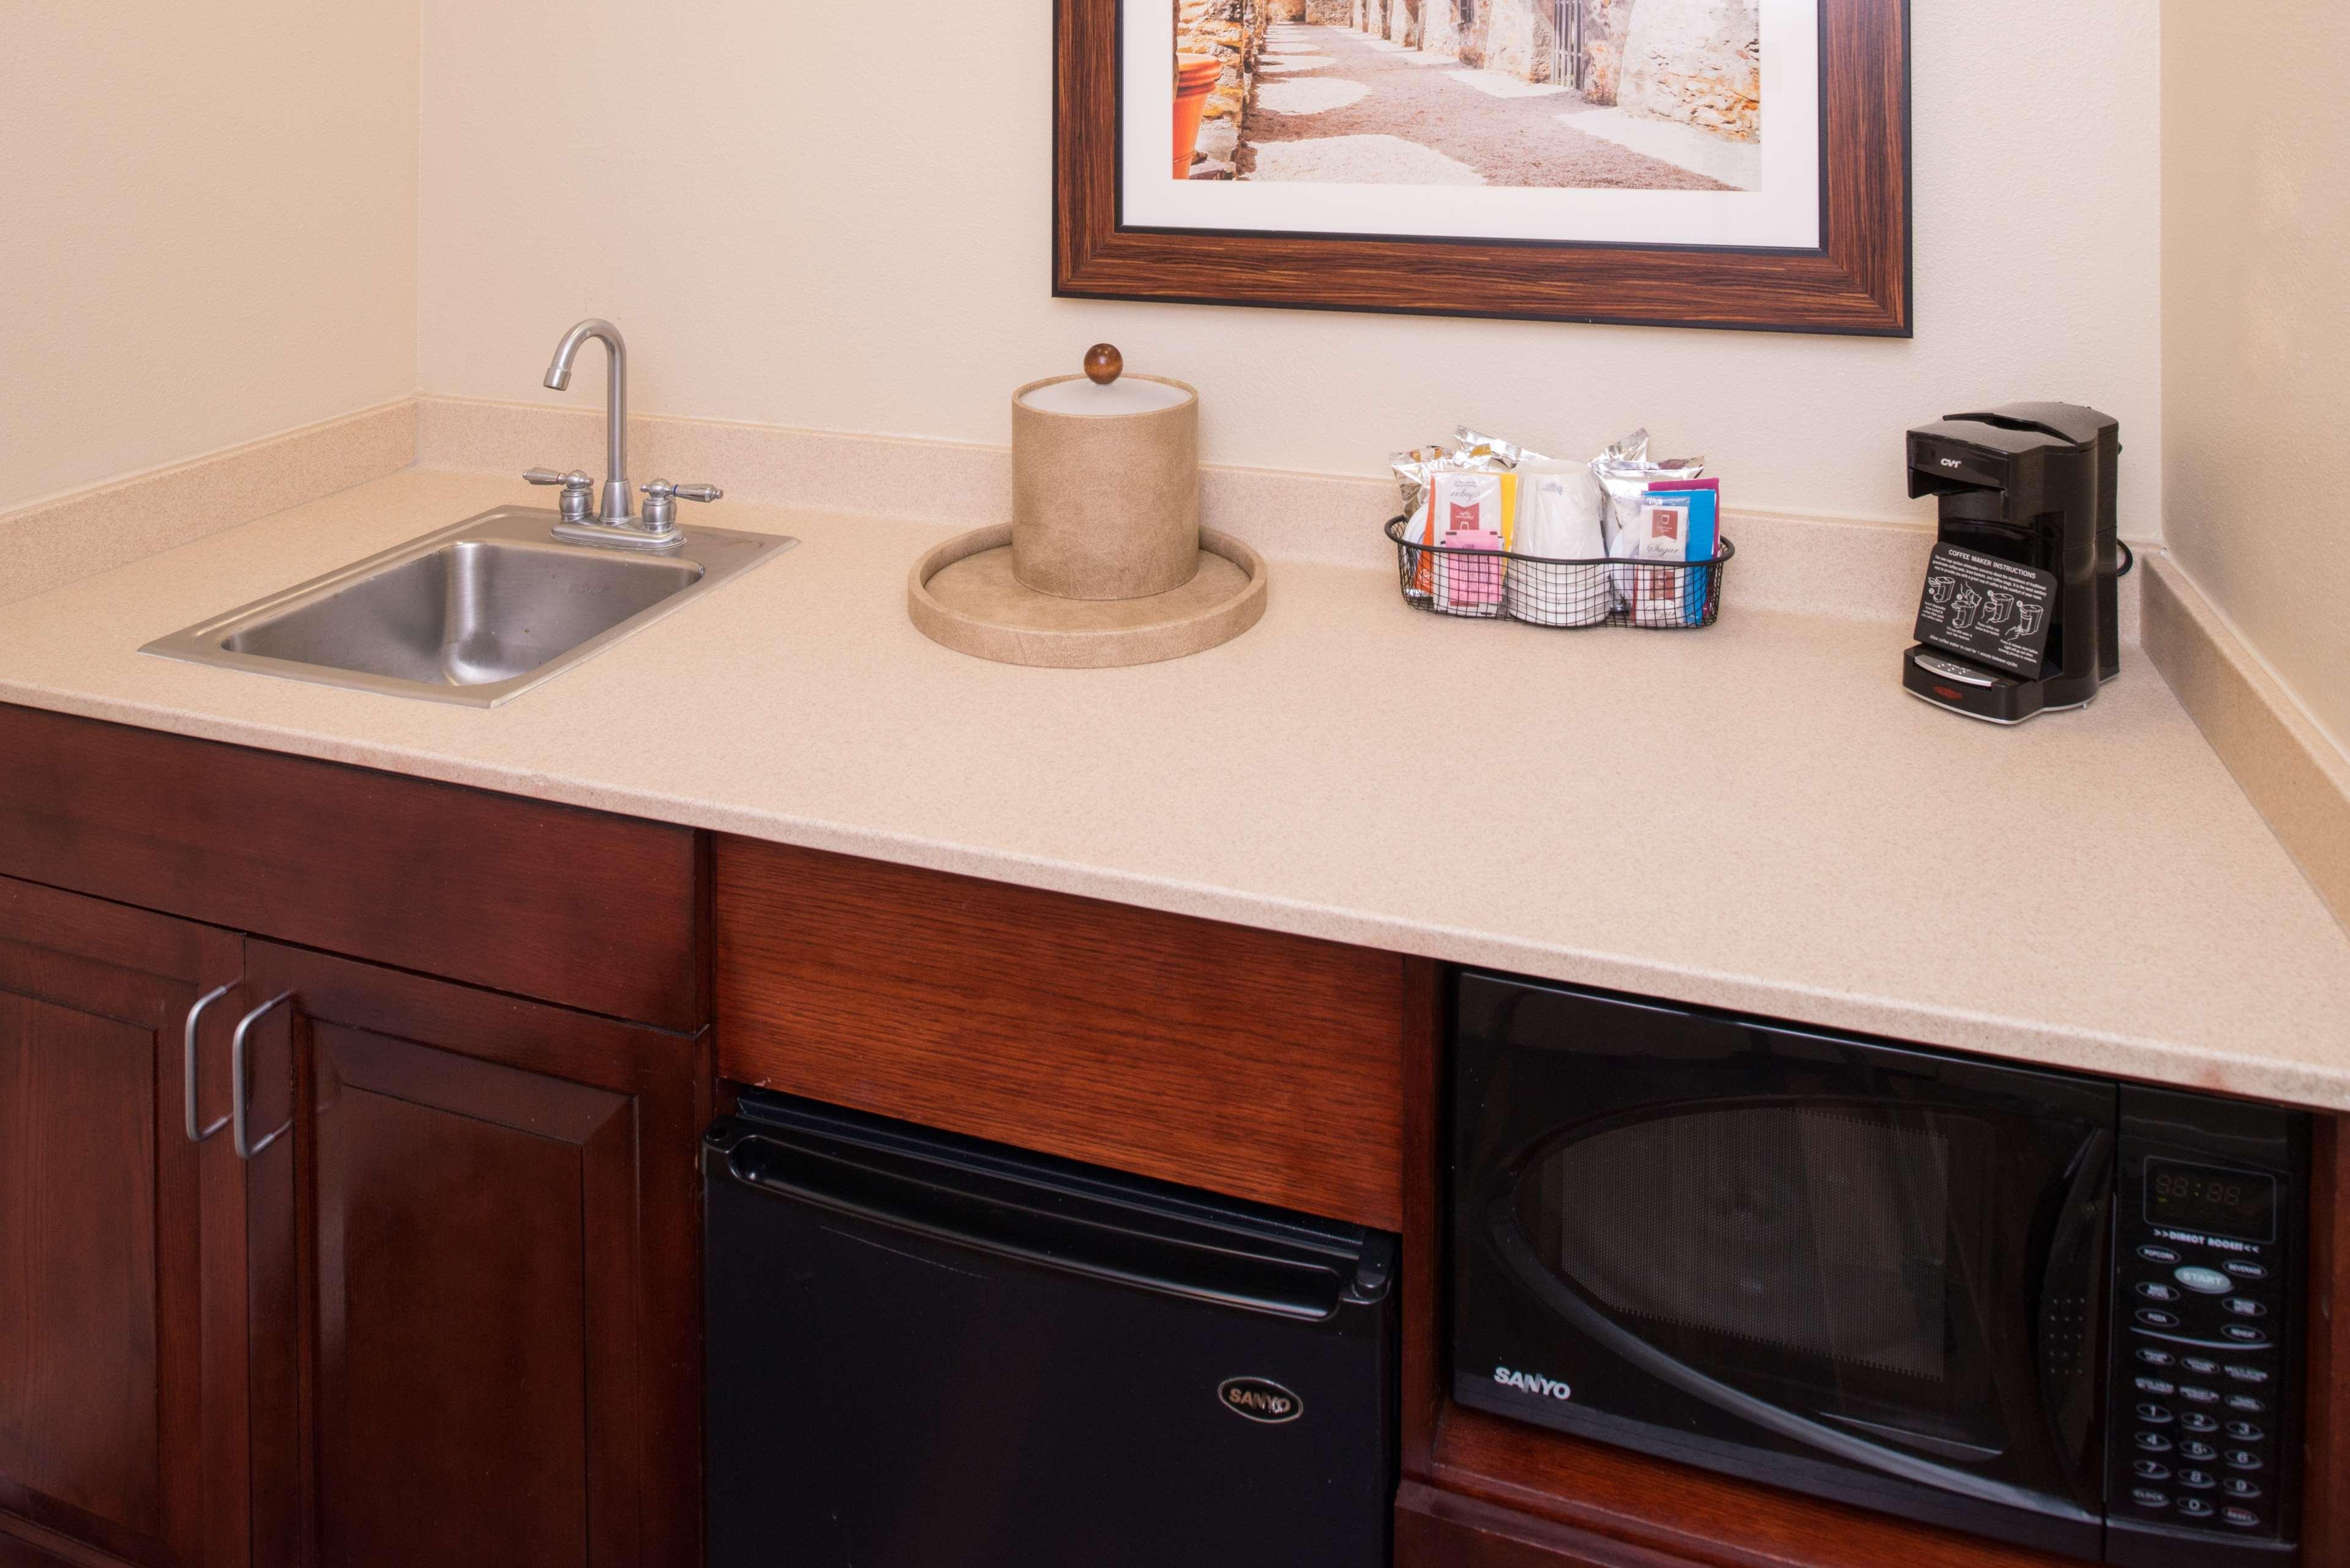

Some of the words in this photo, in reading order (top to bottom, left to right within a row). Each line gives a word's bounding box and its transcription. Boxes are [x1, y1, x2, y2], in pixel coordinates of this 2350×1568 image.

[1647, 542, 1680, 557] Sugar
[1949, 550, 1970, 560] COFFEE
[1971, 556, 1991, 566] MAKER
[1993, 562, 2037, 579] INSTRUCTIONS
[2169, 1231, 2205, 1245] DIRECT
[2183, 1271, 2224, 1285] START
[1494, 1367, 1571, 1400] SANYO
[1229, 1388, 1291, 1414] SANYO
[2150, 1405, 2156, 1417] 1
[2193, 1414, 2204, 1426] 2
[2239, 1422, 2250, 1435] 3
[2146, 1434, 2157, 1445] 4
[2236, 1451, 2249, 1464] 6
[2146, 1461, 2157, 1473] 7
[2188, 1499, 2200, 1511] 0
